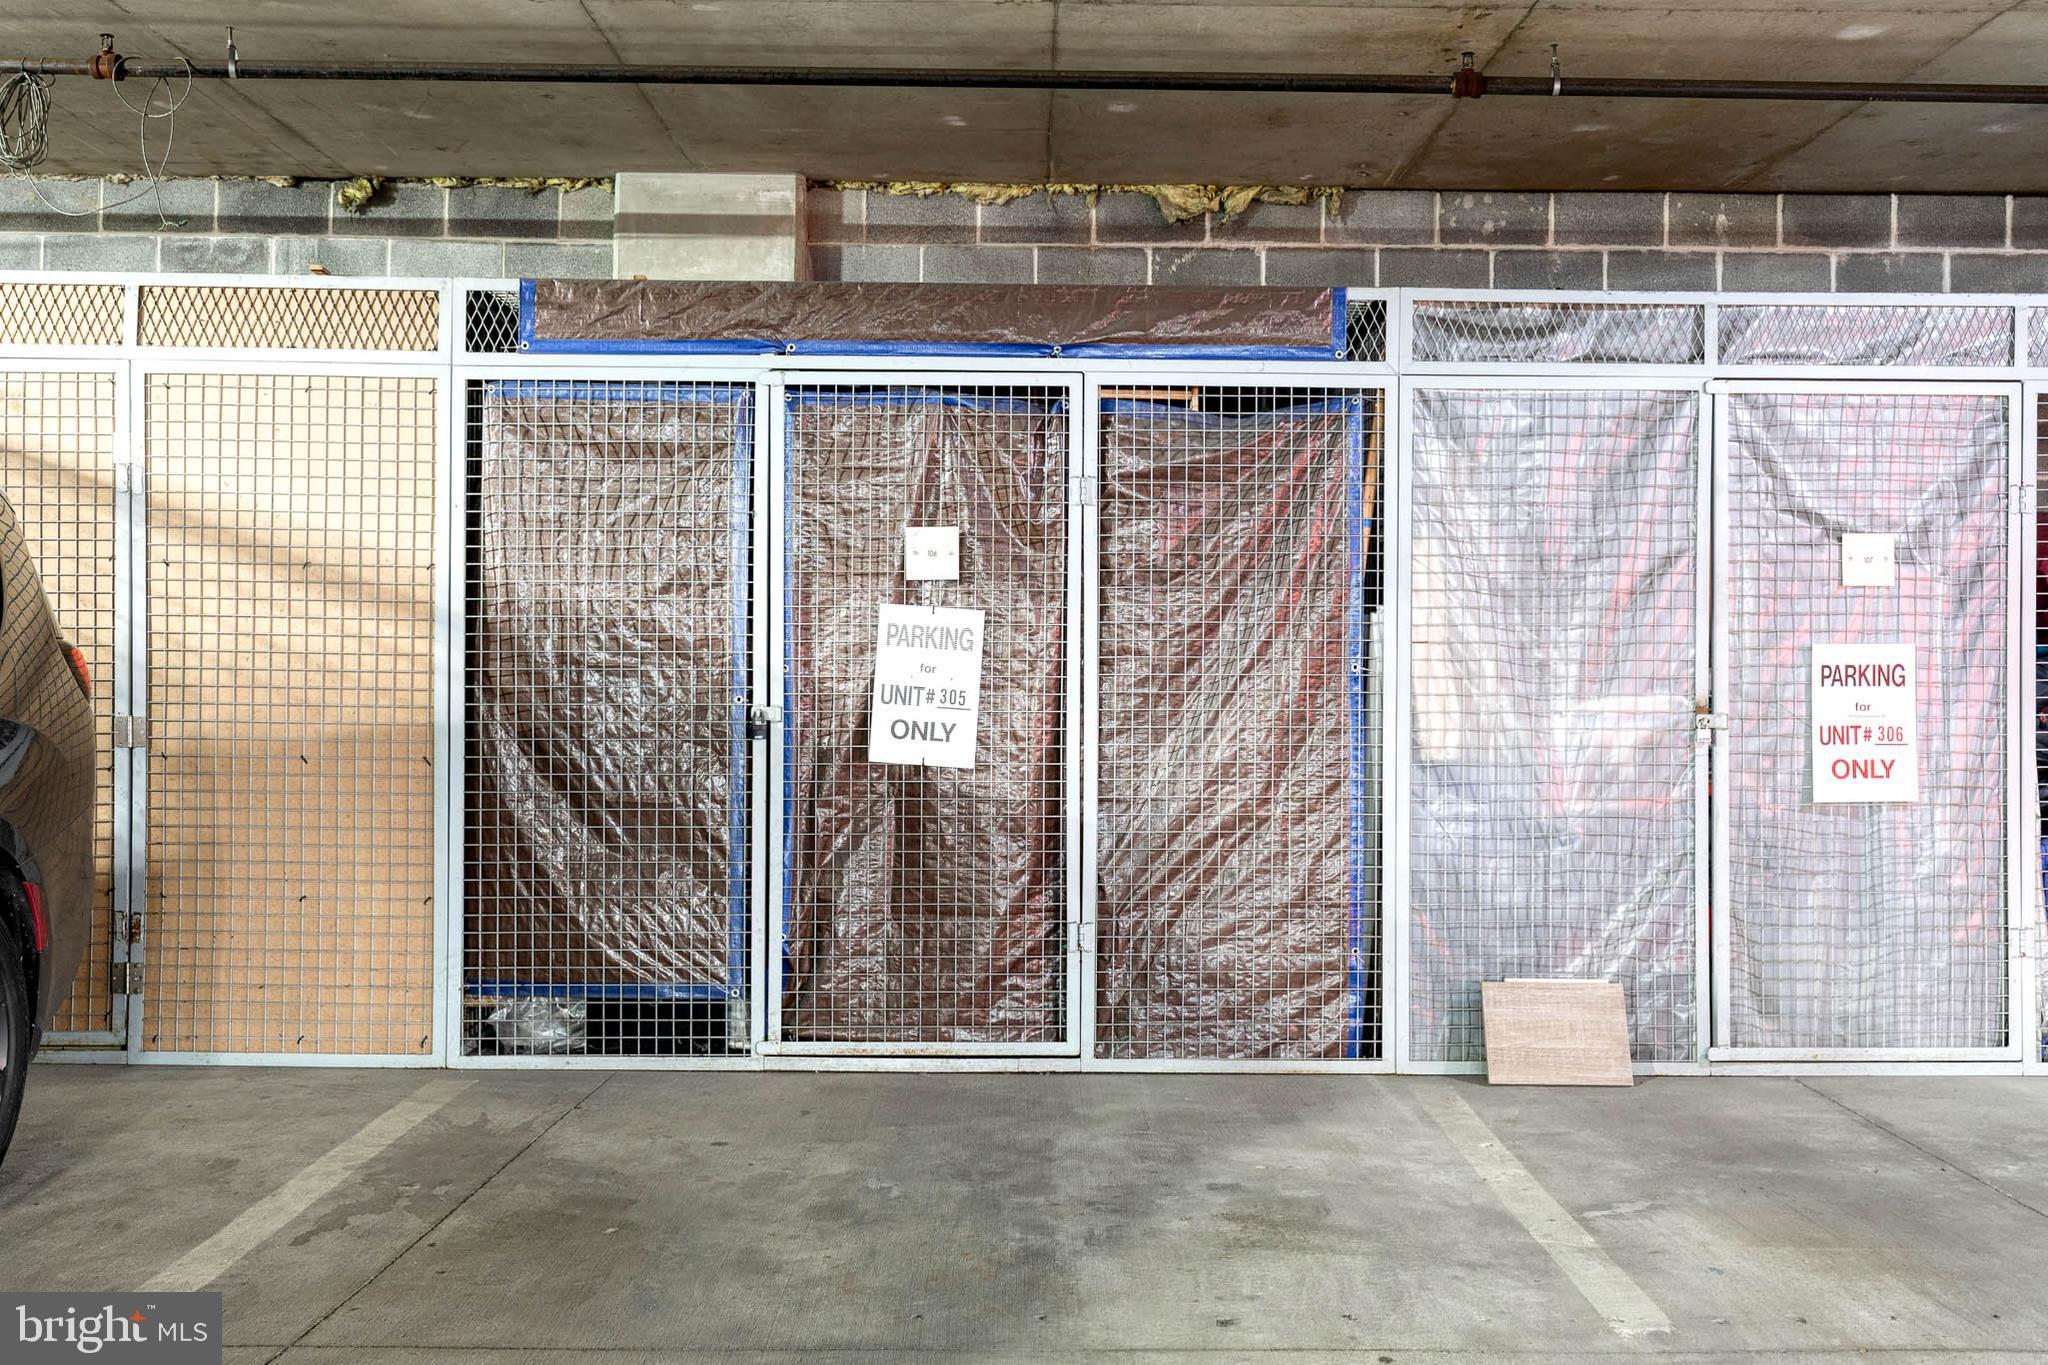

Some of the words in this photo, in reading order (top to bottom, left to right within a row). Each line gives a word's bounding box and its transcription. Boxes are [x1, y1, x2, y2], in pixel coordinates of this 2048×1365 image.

[886, 623, 974, 652] PARKING
[920, 663, 937, 674] for
[1820, 663, 1906, 688] PARKING
[880, 683, 936, 707] UNIT#
[939, 688, 967, 706] 305
[1855, 702, 1872, 712] for
[890, 718, 957, 743] ONLY
[1819, 725, 1873, 746] UNIT#
[1877, 726, 1904, 742] 306
[1831, 758, 1896, 780] ONLY
